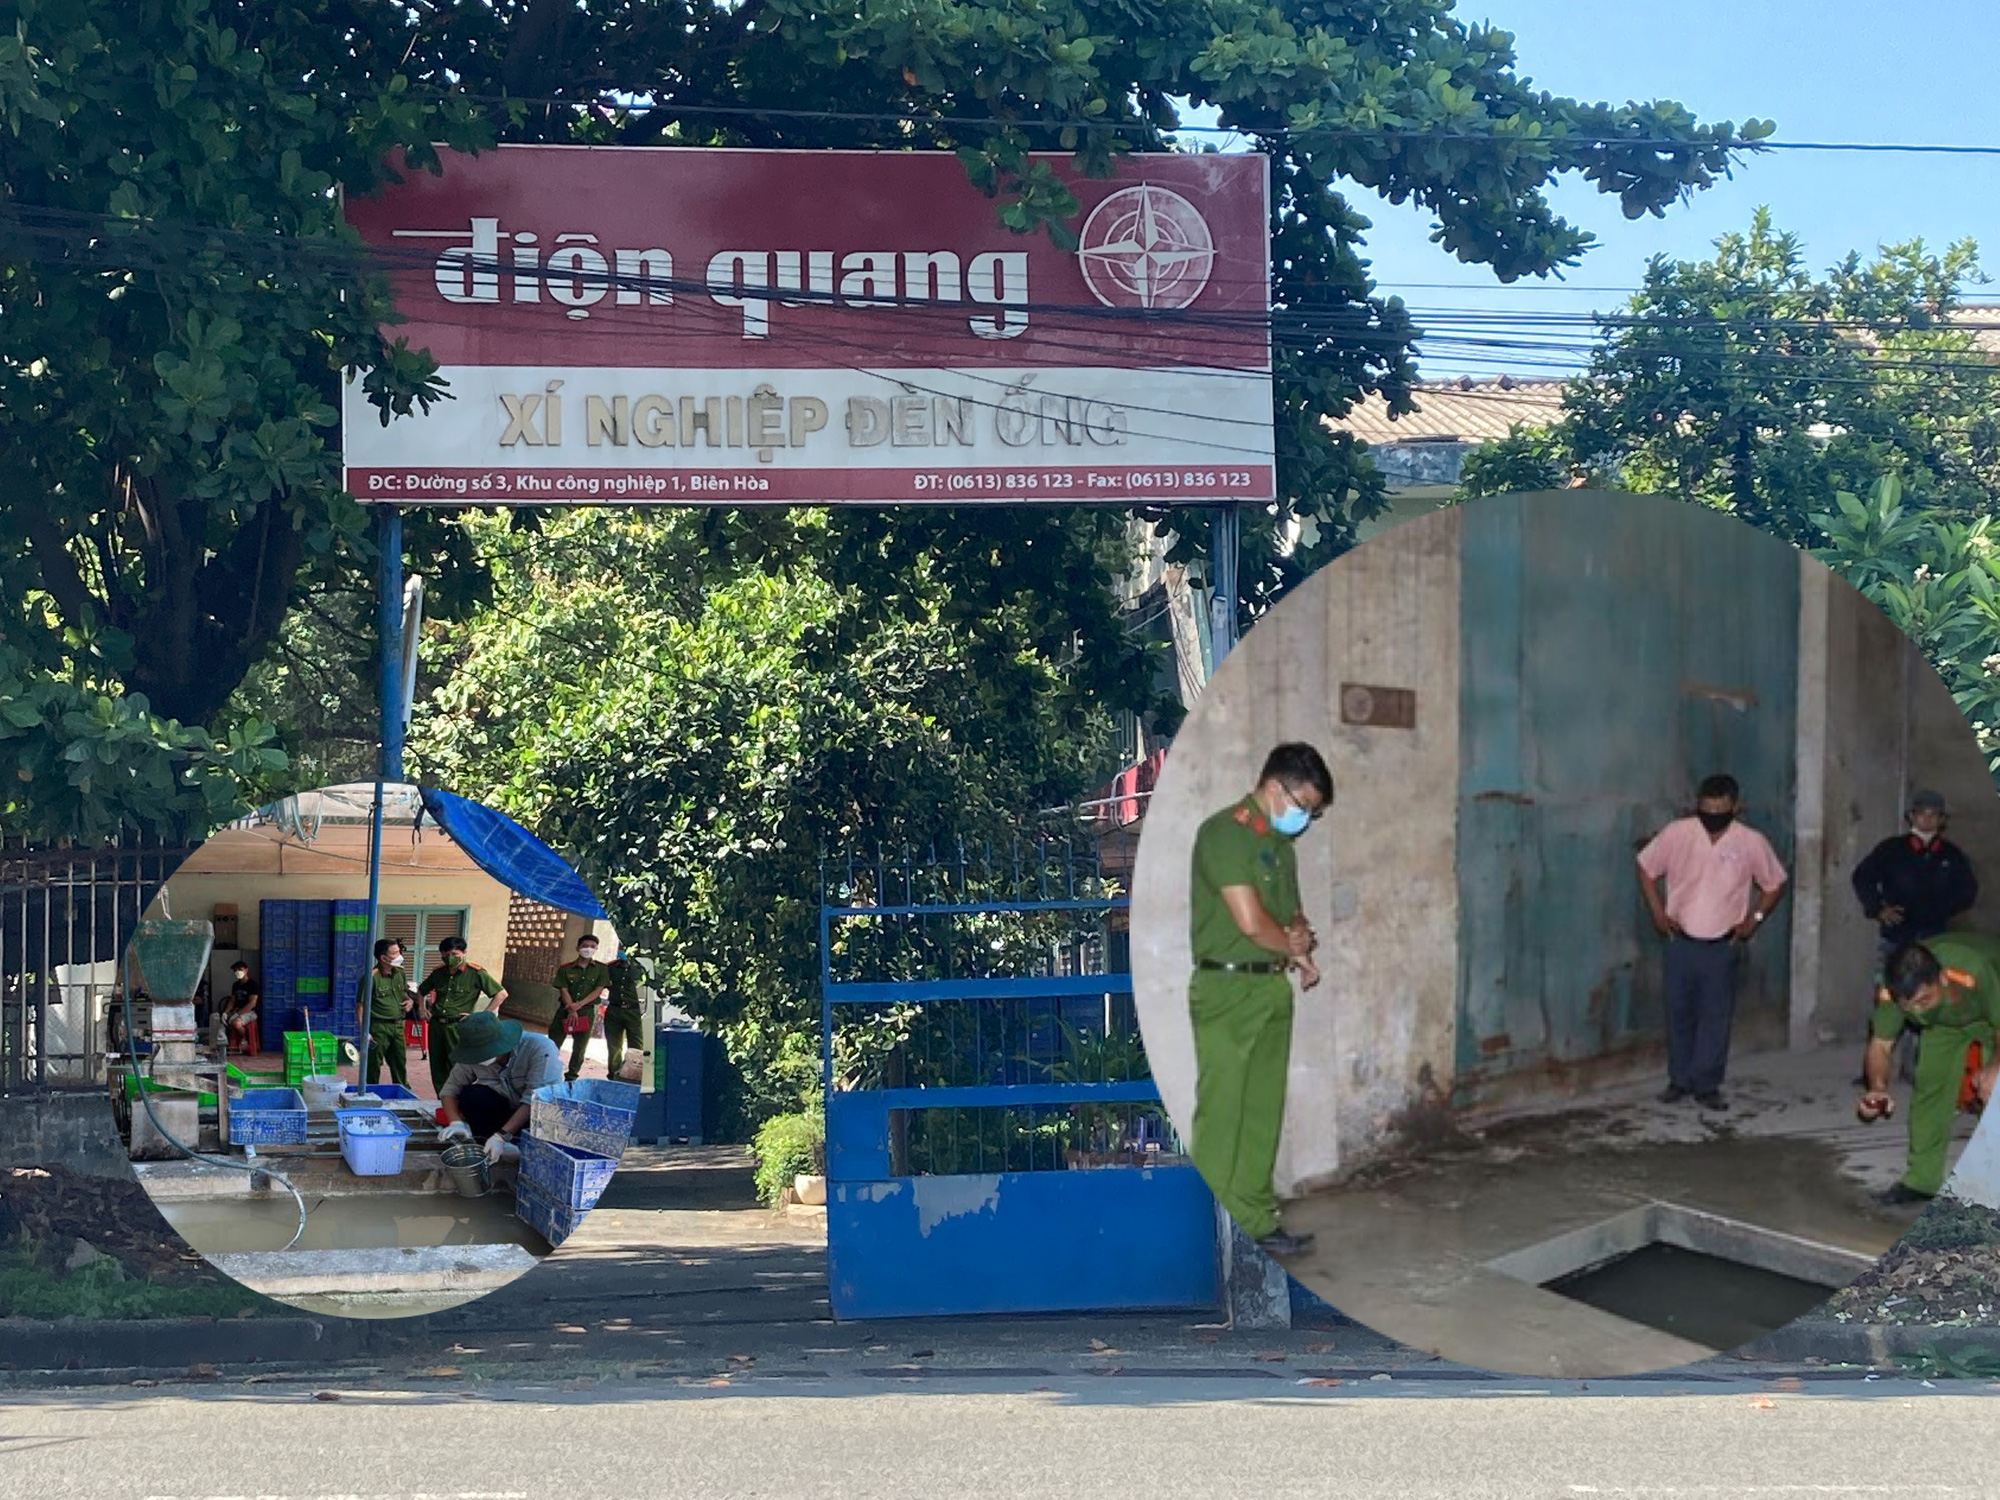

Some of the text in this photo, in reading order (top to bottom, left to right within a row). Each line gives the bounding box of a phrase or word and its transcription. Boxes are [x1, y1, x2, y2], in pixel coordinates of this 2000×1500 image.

[392, 217, 1028, 340] điện quang
[499, 372, 1128, 463] XÍ NGHIỆP ĐÈN ỐNG
[368, 472, 770, 494] ĐC: Đường số 3, Khu công nghiệp 1, Biên Hòa
[913, 473, 944, 490] ĐT:
[947, 473, 1002, 492] (0613)
[1005, 473, 1038, 489] 836
[1042, 473, 1073, 489] 123
[1087, 472, 1123, 488] Fax:
[1125, 471, 1180, 490] (0613)
[1183, 472, 1216, 487] 836
[1219, 471, 1251, 487] 123
